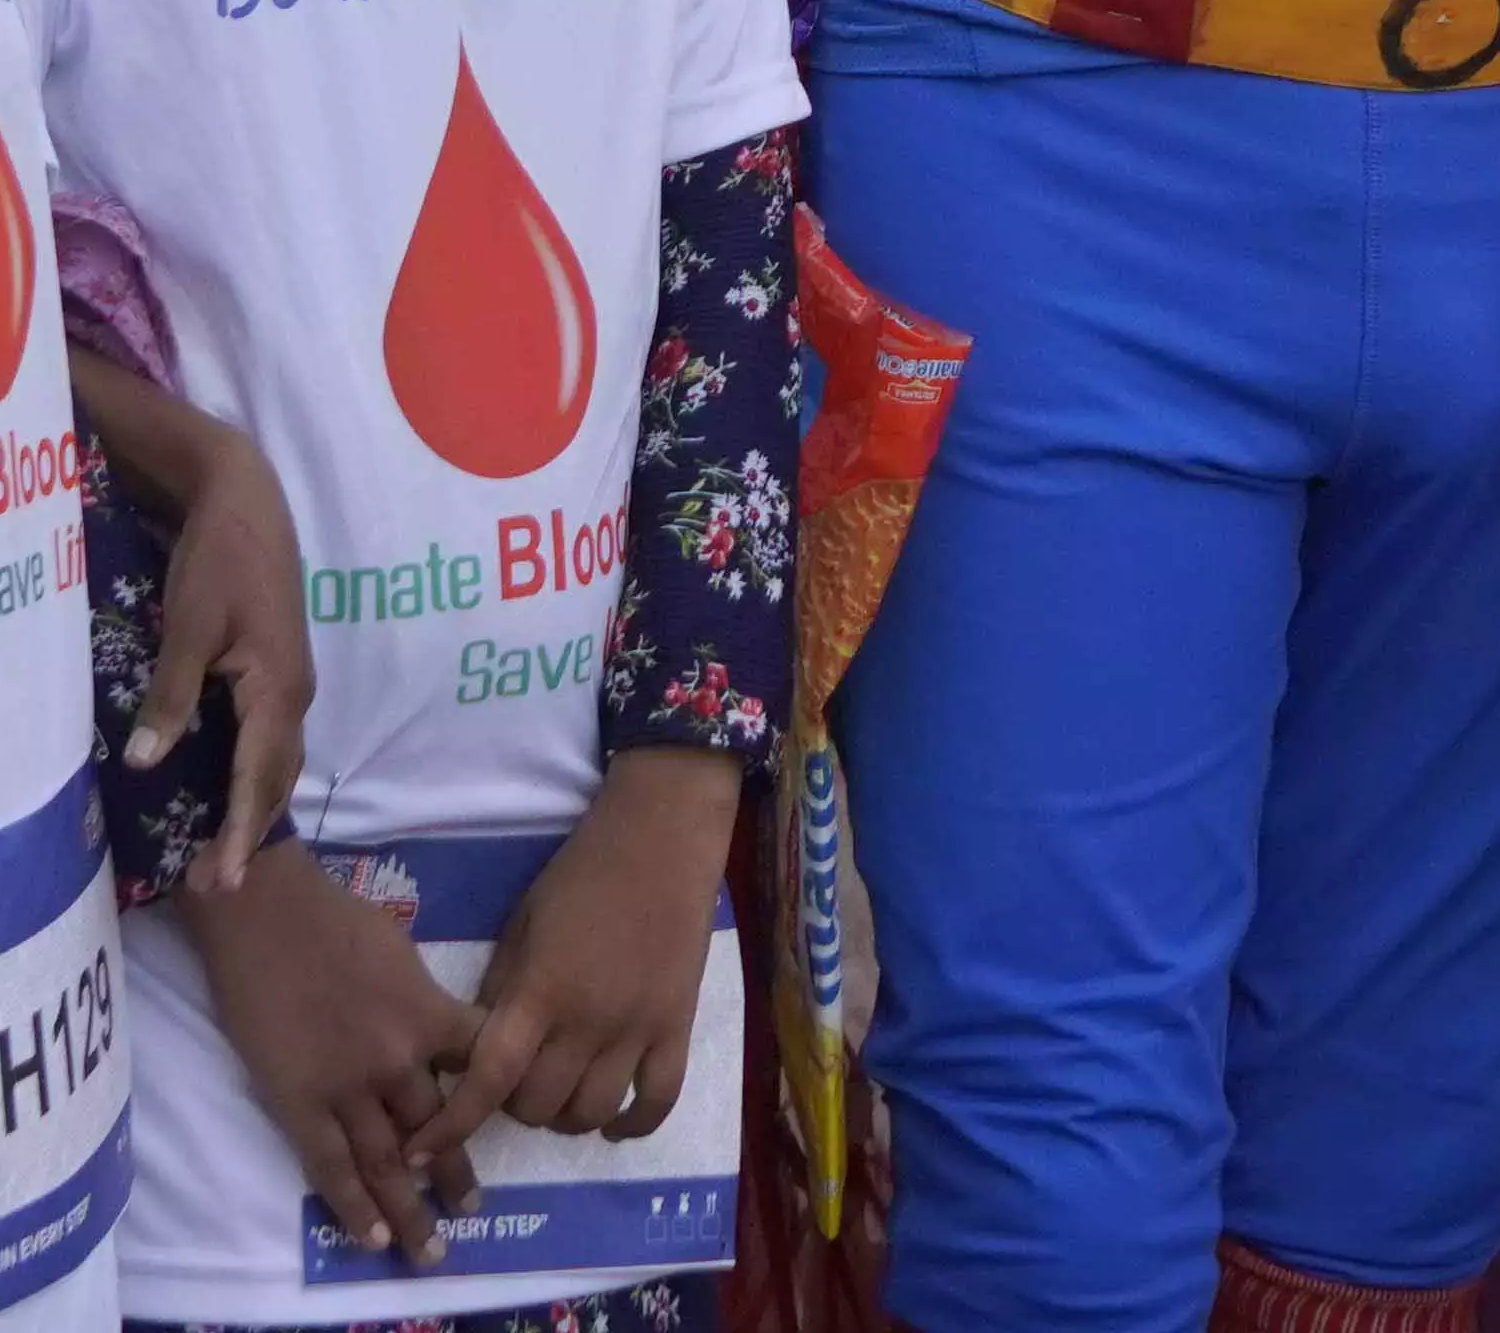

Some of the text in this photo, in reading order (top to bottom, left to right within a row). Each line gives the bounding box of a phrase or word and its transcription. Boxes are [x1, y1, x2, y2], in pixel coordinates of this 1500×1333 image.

[53, 520, 88, 593] Lif
[300, 479, 630, 626] onate Blood
[455, 632, 596, 706] Save
[435, 1216, 491, 1243] EVERY
